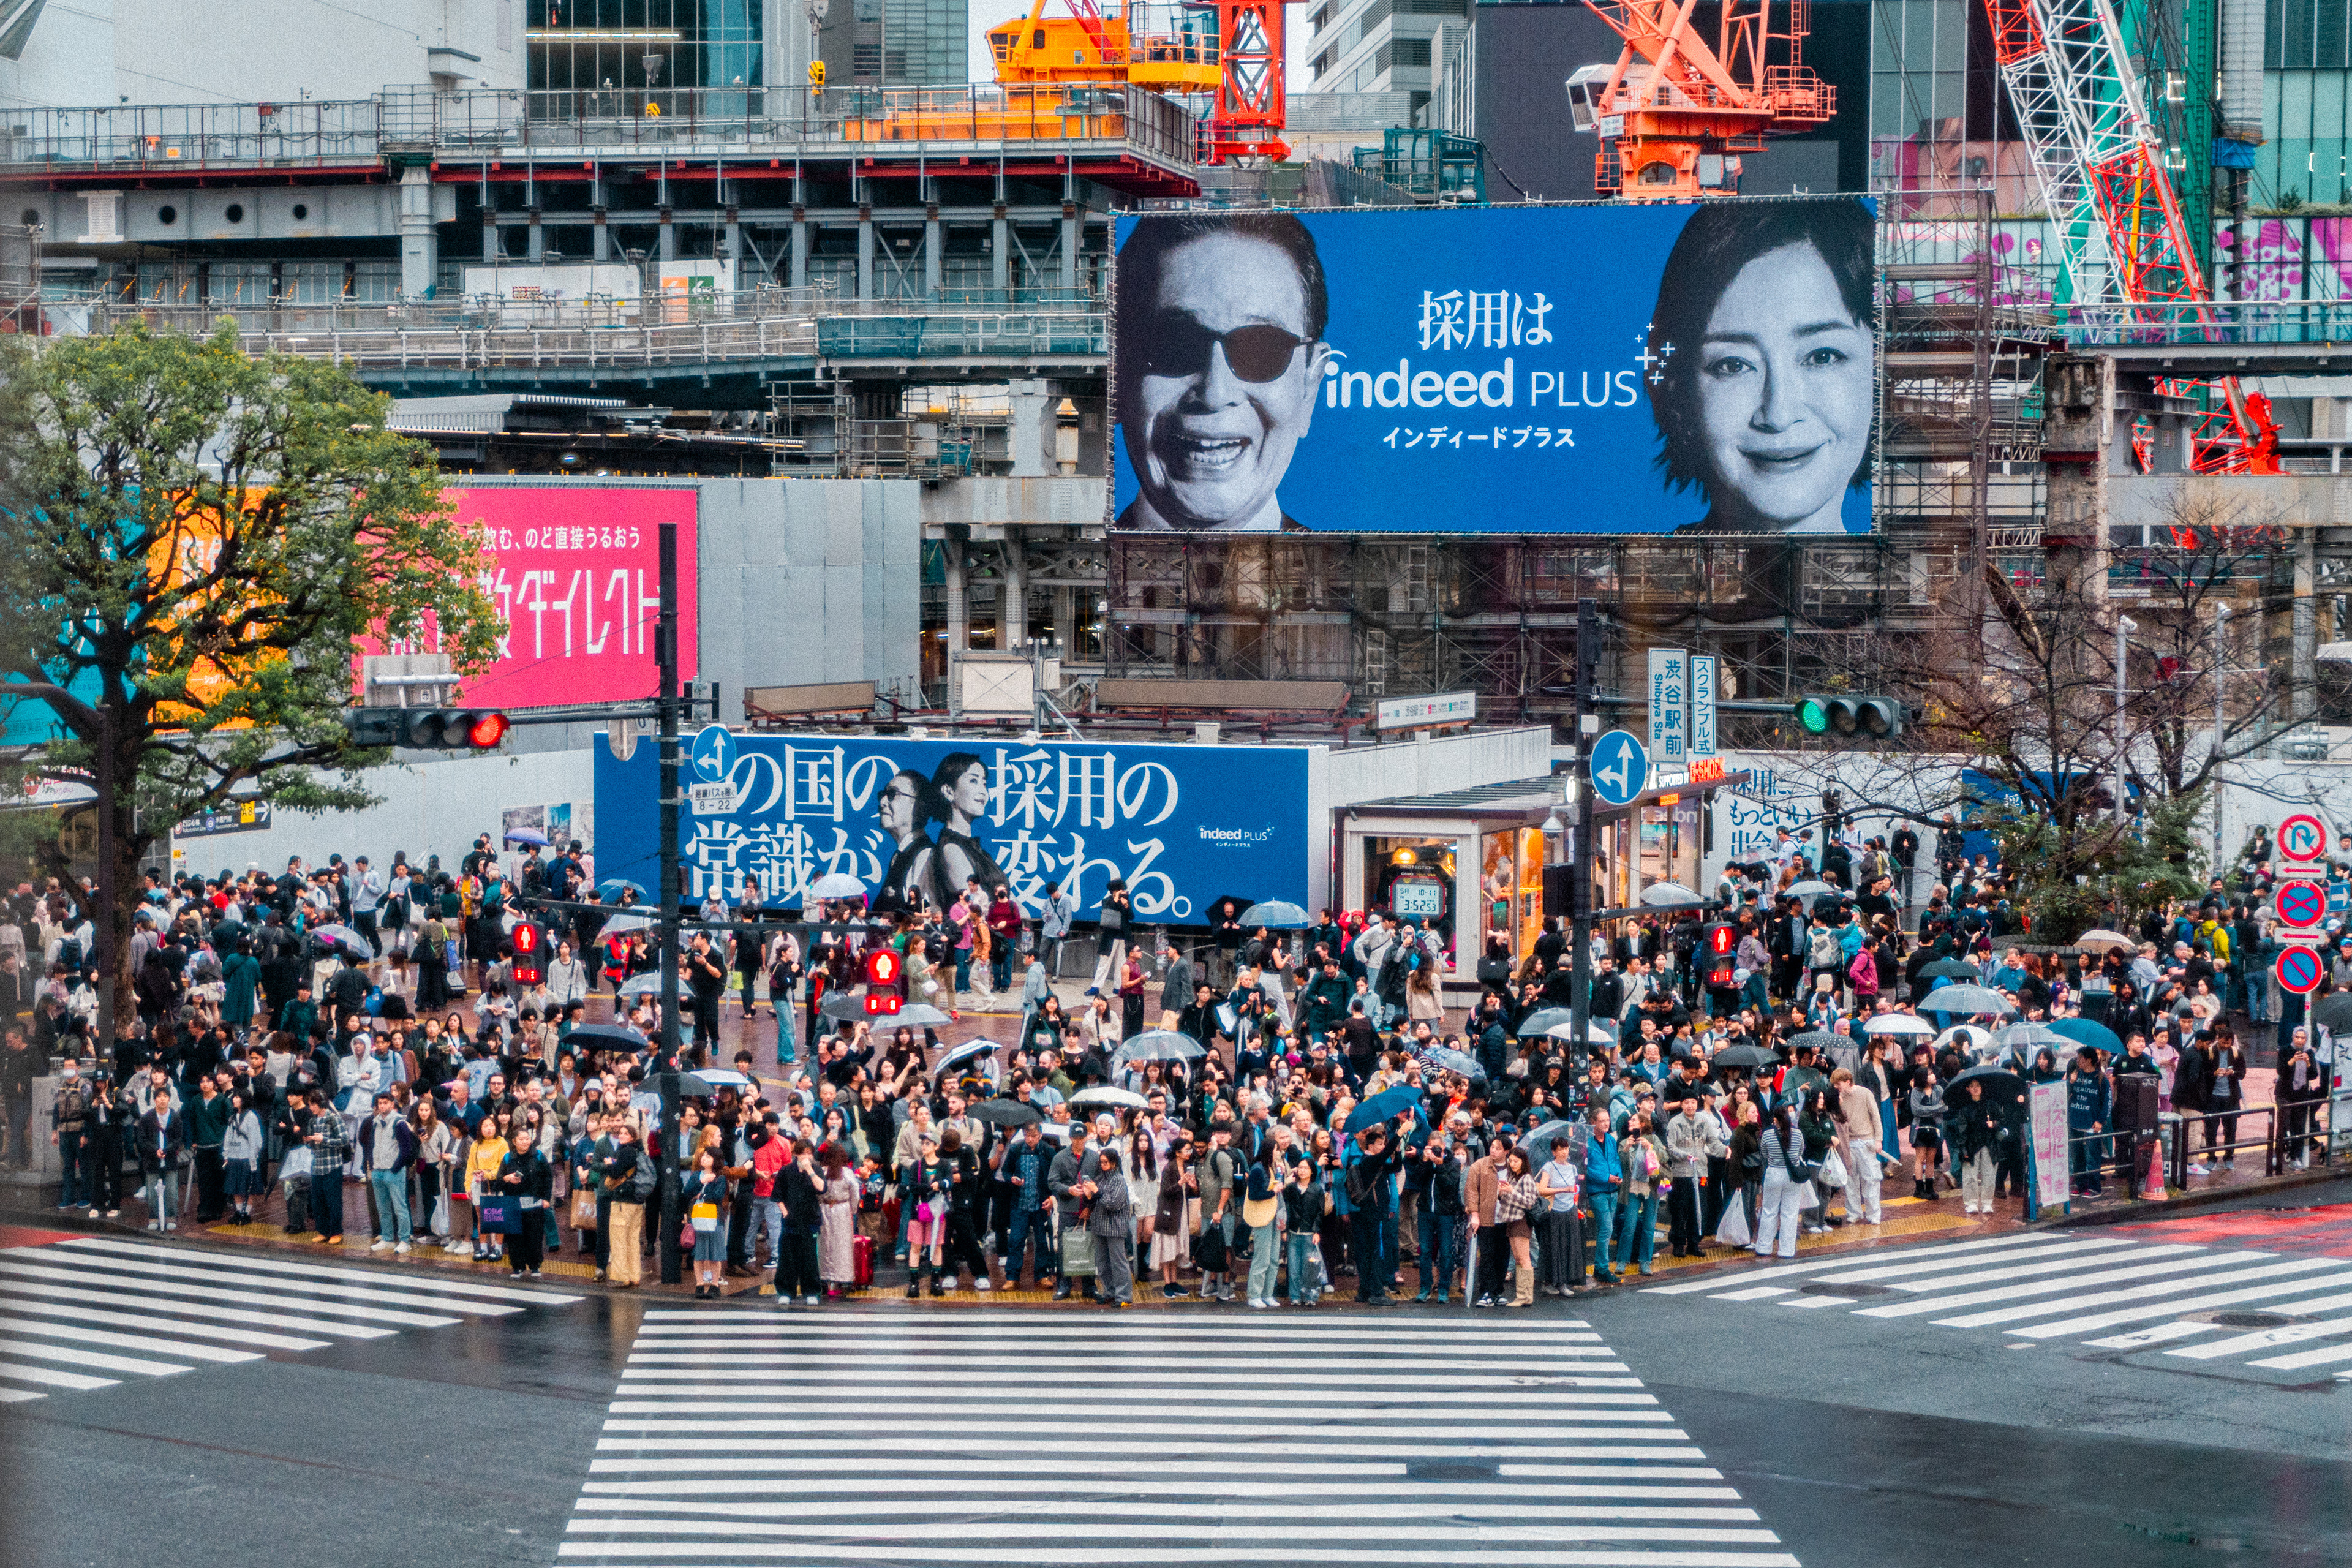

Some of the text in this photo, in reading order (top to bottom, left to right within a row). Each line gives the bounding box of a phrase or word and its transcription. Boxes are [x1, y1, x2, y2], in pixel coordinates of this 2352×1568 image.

[1418, 289, 1553, 350] 採用は
[1311, 351, 1637, 409] indeed PLUS
[1383, 425, 1575, 448] インディードプラス
[1653, 673, 1663, 743] Shibuya Sta.
[1665, 658, 1682, 755] 渋谷駅前
[1697, 661, 1711, 752] スクランブル式
[690, 743, 1178, 829] の国の 採用の
[1659, 772, 1683, 788] SUPPORTED
[1689, 756, 1726, 783] G-SHOCK
[1198, 826, 1267, 840] indeed PLUS
[685, 821, 1192, 919] 常識が 変わる。
